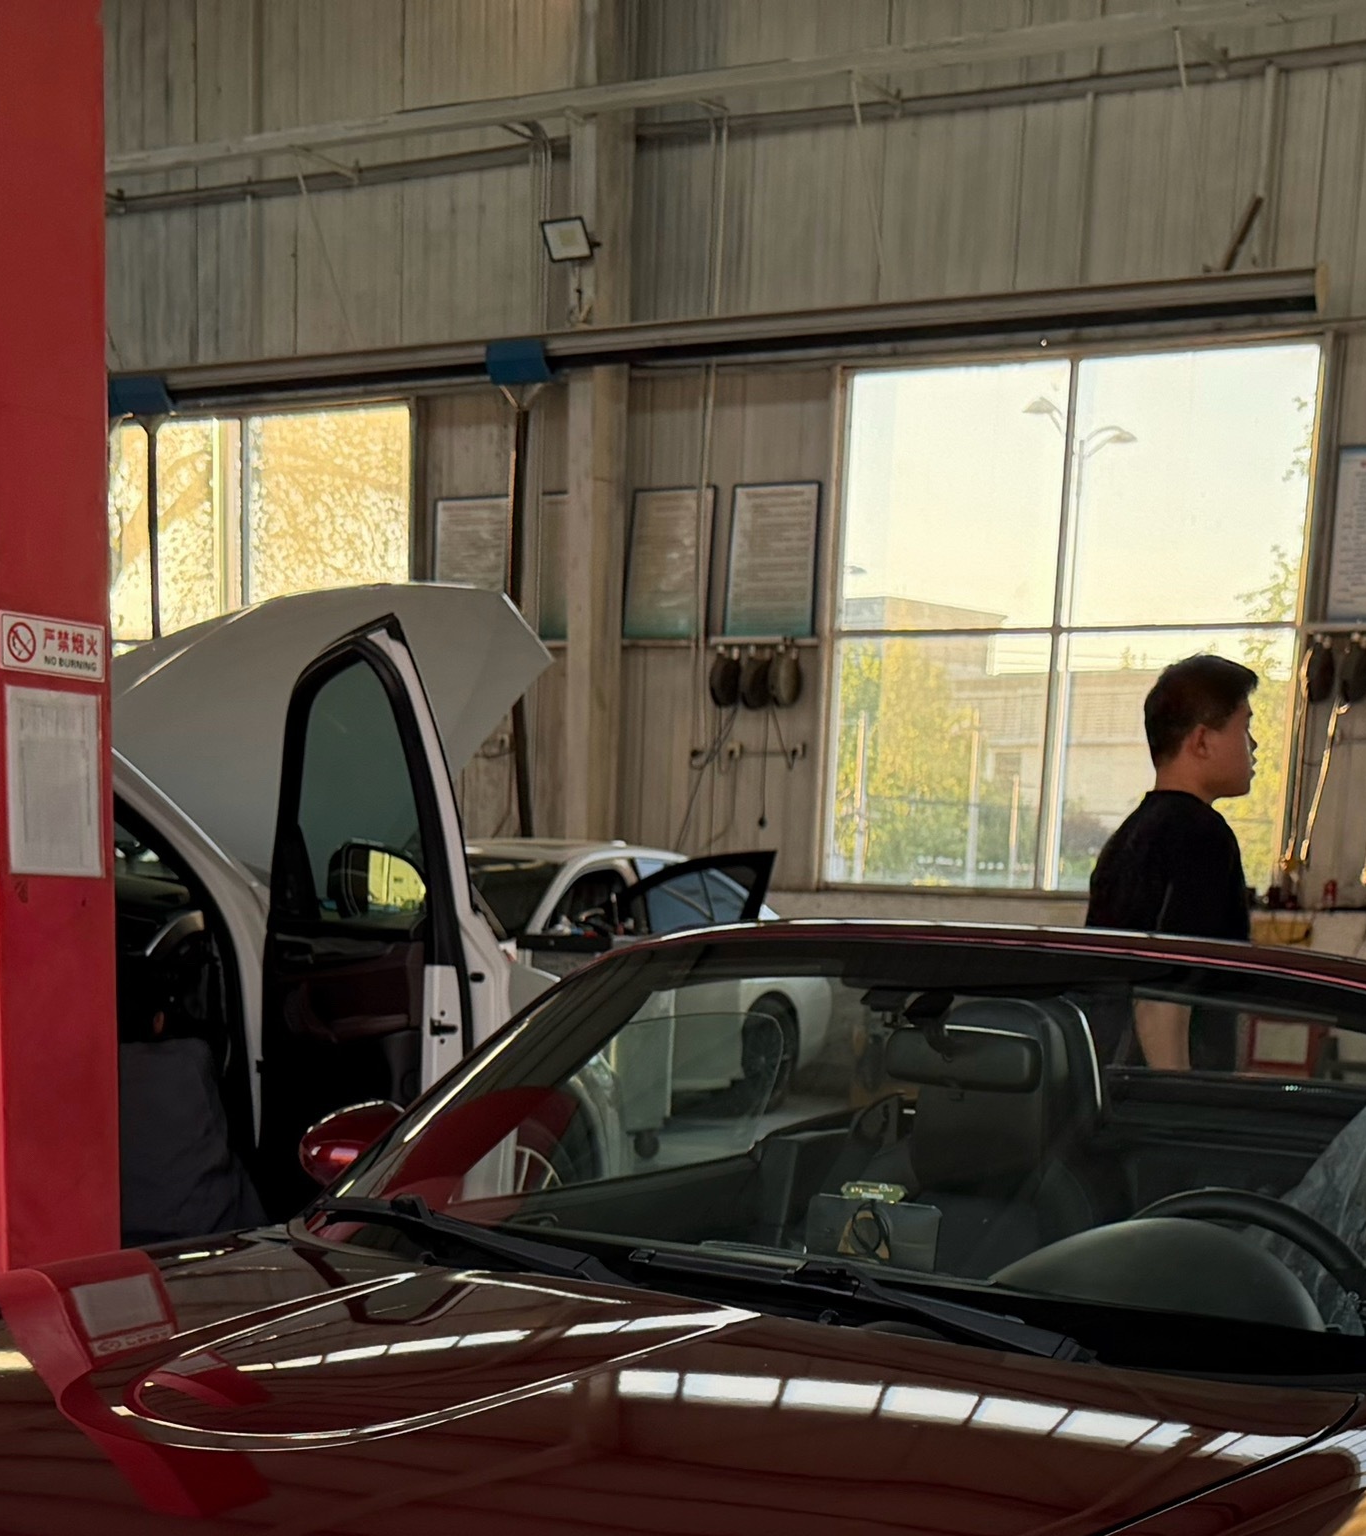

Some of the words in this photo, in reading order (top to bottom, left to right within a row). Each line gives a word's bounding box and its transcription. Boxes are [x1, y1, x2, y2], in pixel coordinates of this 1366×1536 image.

[42, 627, 98, 657] 严禁烟火
[44, 655, 57, 666] NO
[58, 657, 98, 672] BURNING
